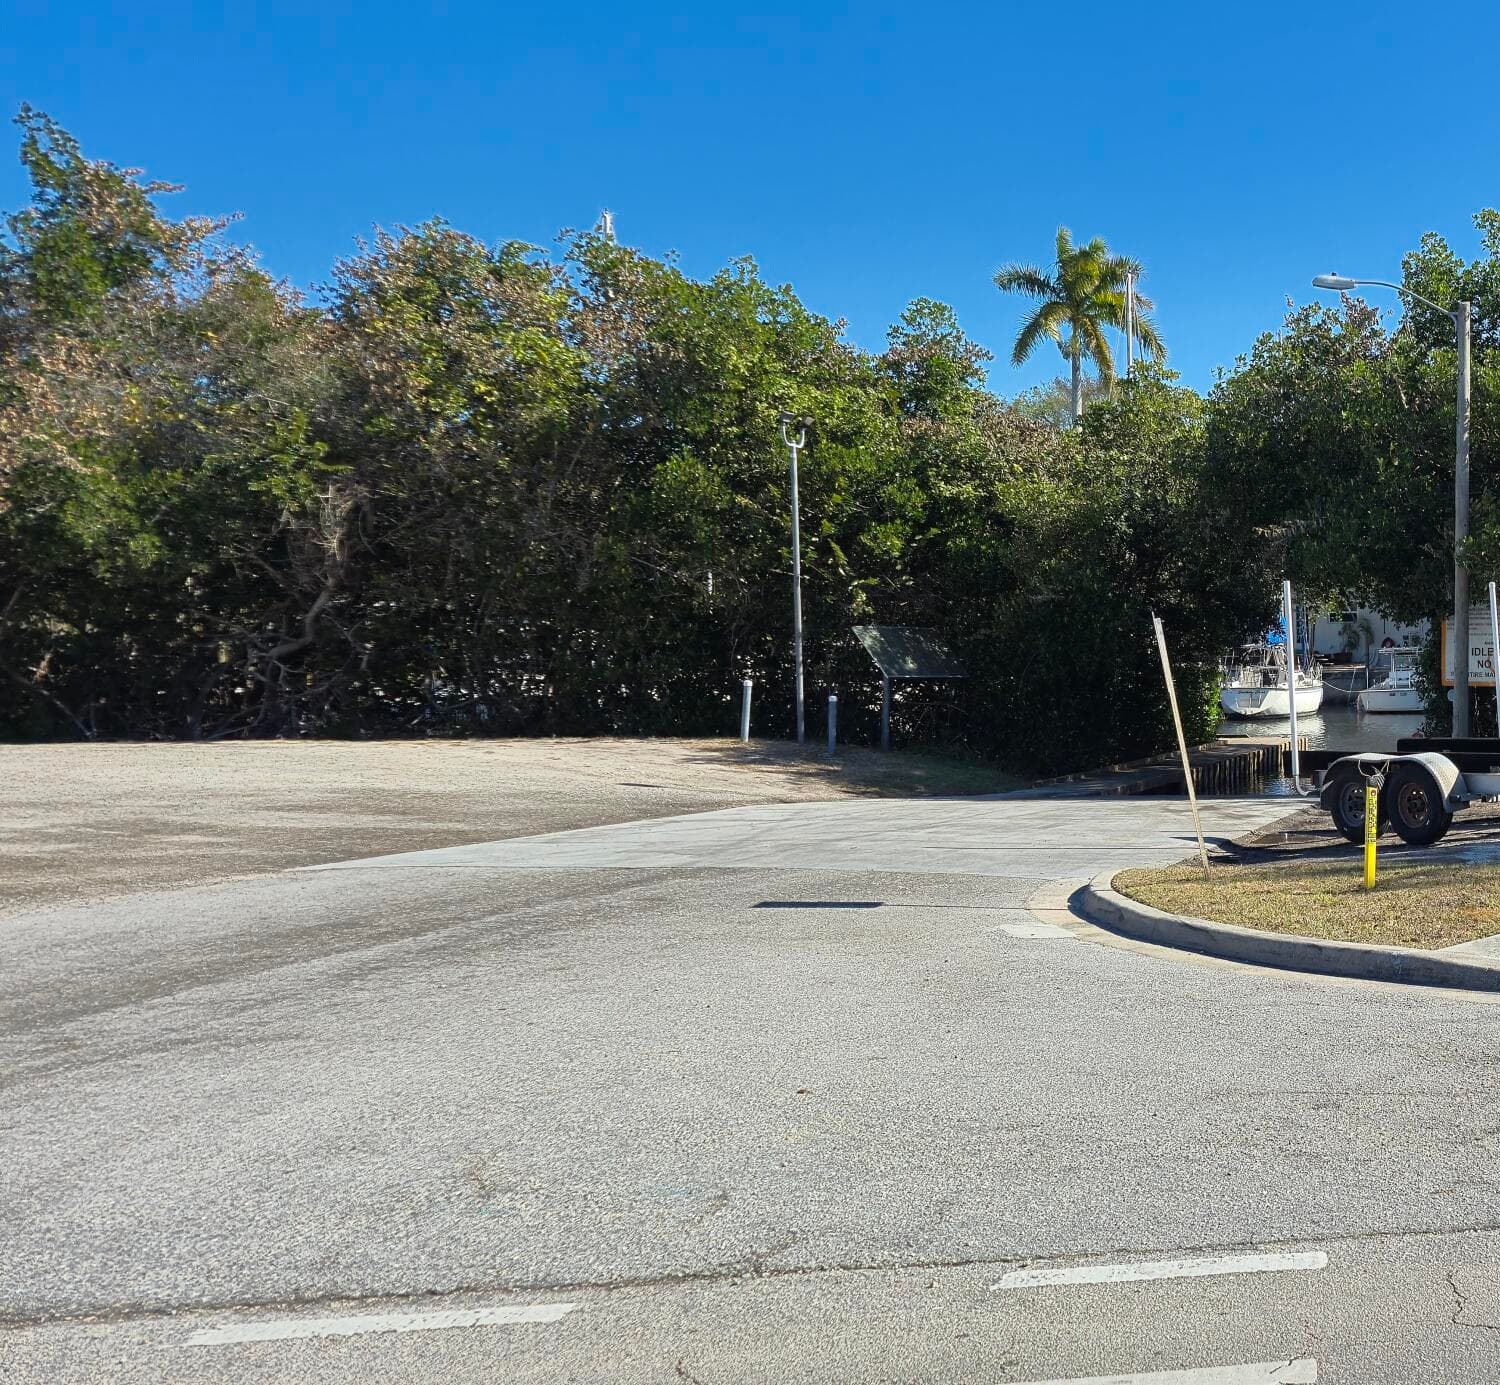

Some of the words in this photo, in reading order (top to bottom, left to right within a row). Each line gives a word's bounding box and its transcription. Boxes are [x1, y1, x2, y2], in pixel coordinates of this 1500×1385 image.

[1471, 647, 1494, 657] IDLE
[1477, 659, 1492, 669] NO
[1468, 671, 1484, 679] TIRE
